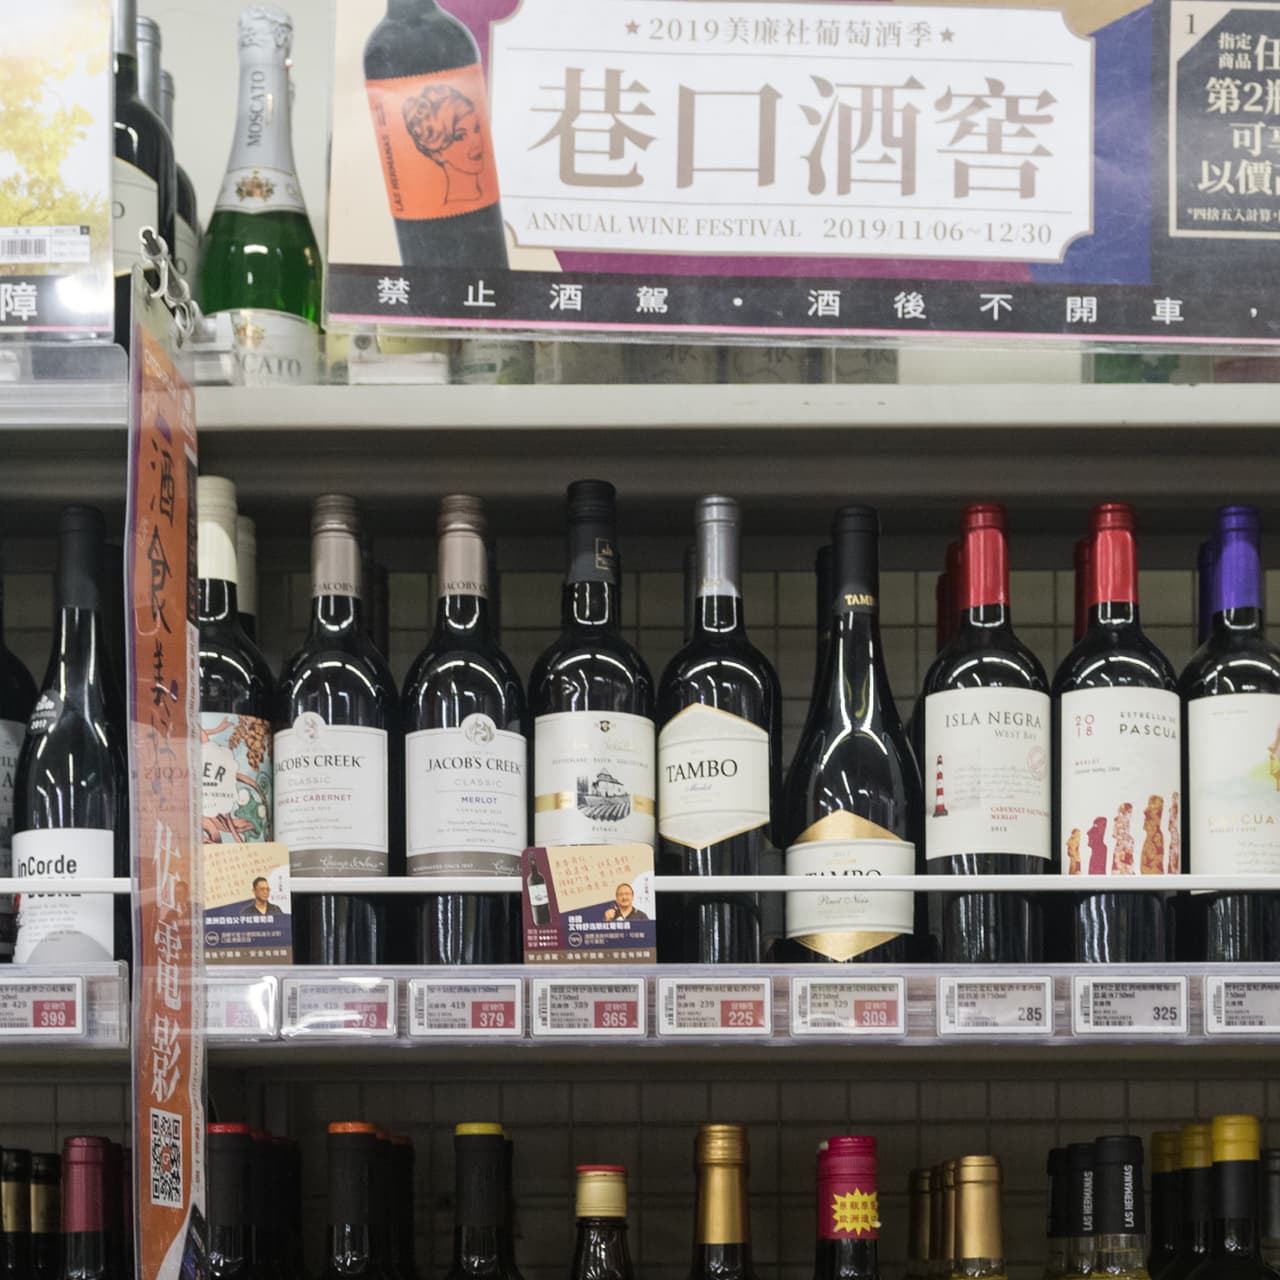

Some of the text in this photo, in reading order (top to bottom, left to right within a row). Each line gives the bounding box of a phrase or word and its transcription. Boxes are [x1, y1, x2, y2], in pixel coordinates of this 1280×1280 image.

[648, 14, 934, 49] 2019美廉社葡萄酒季
[1186, 14, 1195, 34] 1
[526, 67, 1058, 200] 巷口酒窖
[526, 214, 1053, 245] ANNUAL WINE FESTIVAL 2019/11/06~12/30
[945, 712, 1042, 729] ISLA NEGRA
[1119, 723, 1177, 739] PASCUA
[314, 753, 362, 769] CREEK
[425, 755, 521, 773] JACOB'S CREEK
[665, 758, 739, 783] TAMBO
[602, 1012, 627, 1028] 365
[1017, 1006, 1043, 1023] 285
